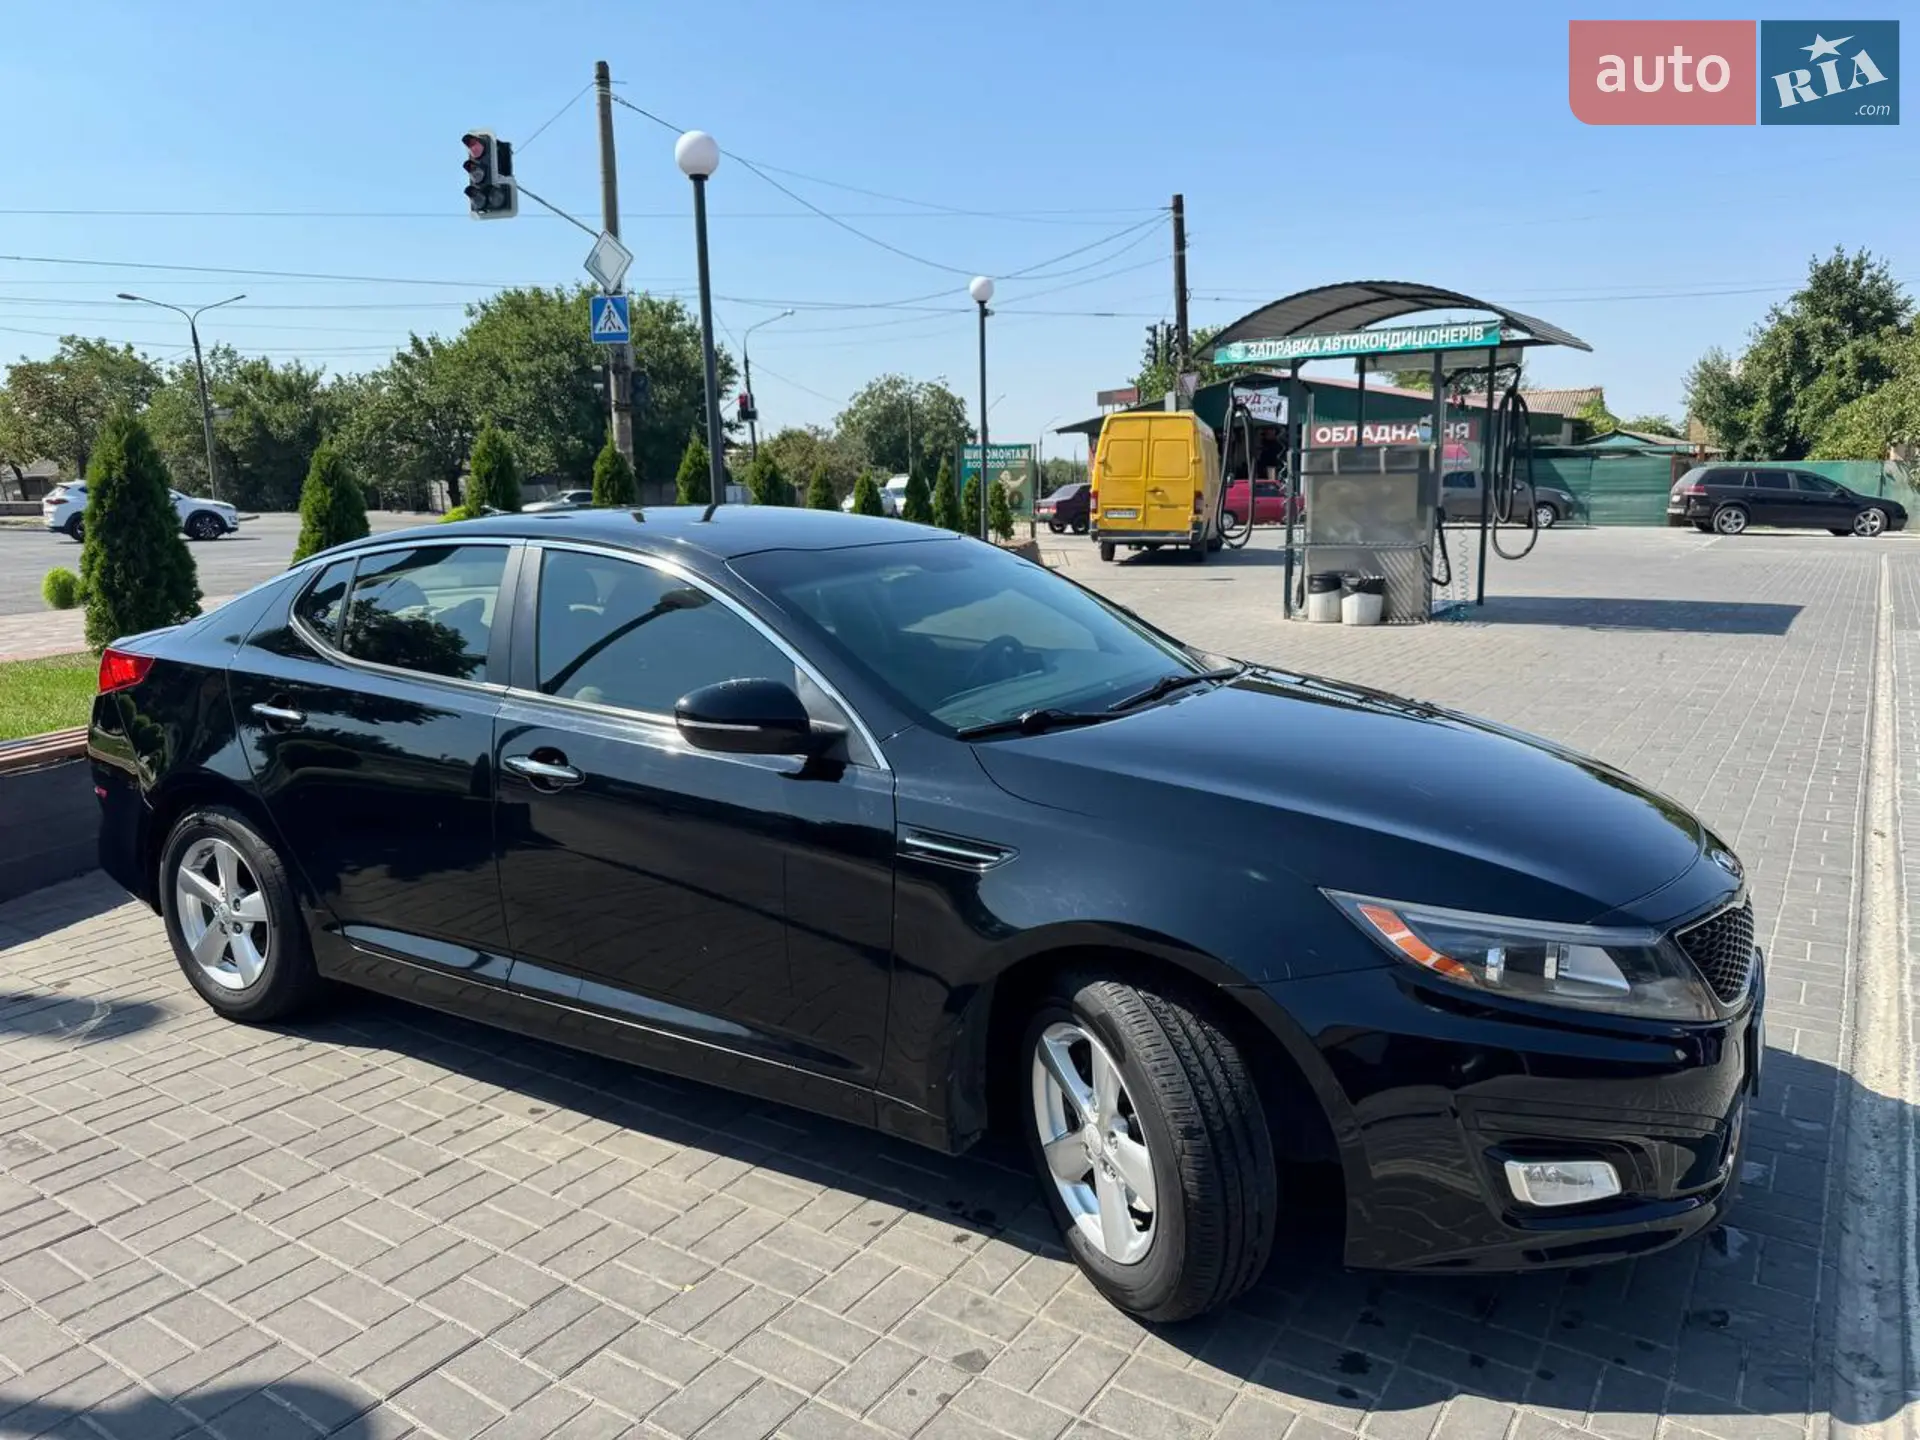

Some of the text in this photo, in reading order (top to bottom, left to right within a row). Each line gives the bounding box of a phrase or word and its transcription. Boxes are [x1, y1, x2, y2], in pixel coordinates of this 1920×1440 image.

[1249, 325, 1484, 358] ЗАПРАВКА АВТОКОНДИЦІОНЕРІВ
[1316, 422, 1470, 443] ОБЛАДНАНЯ
